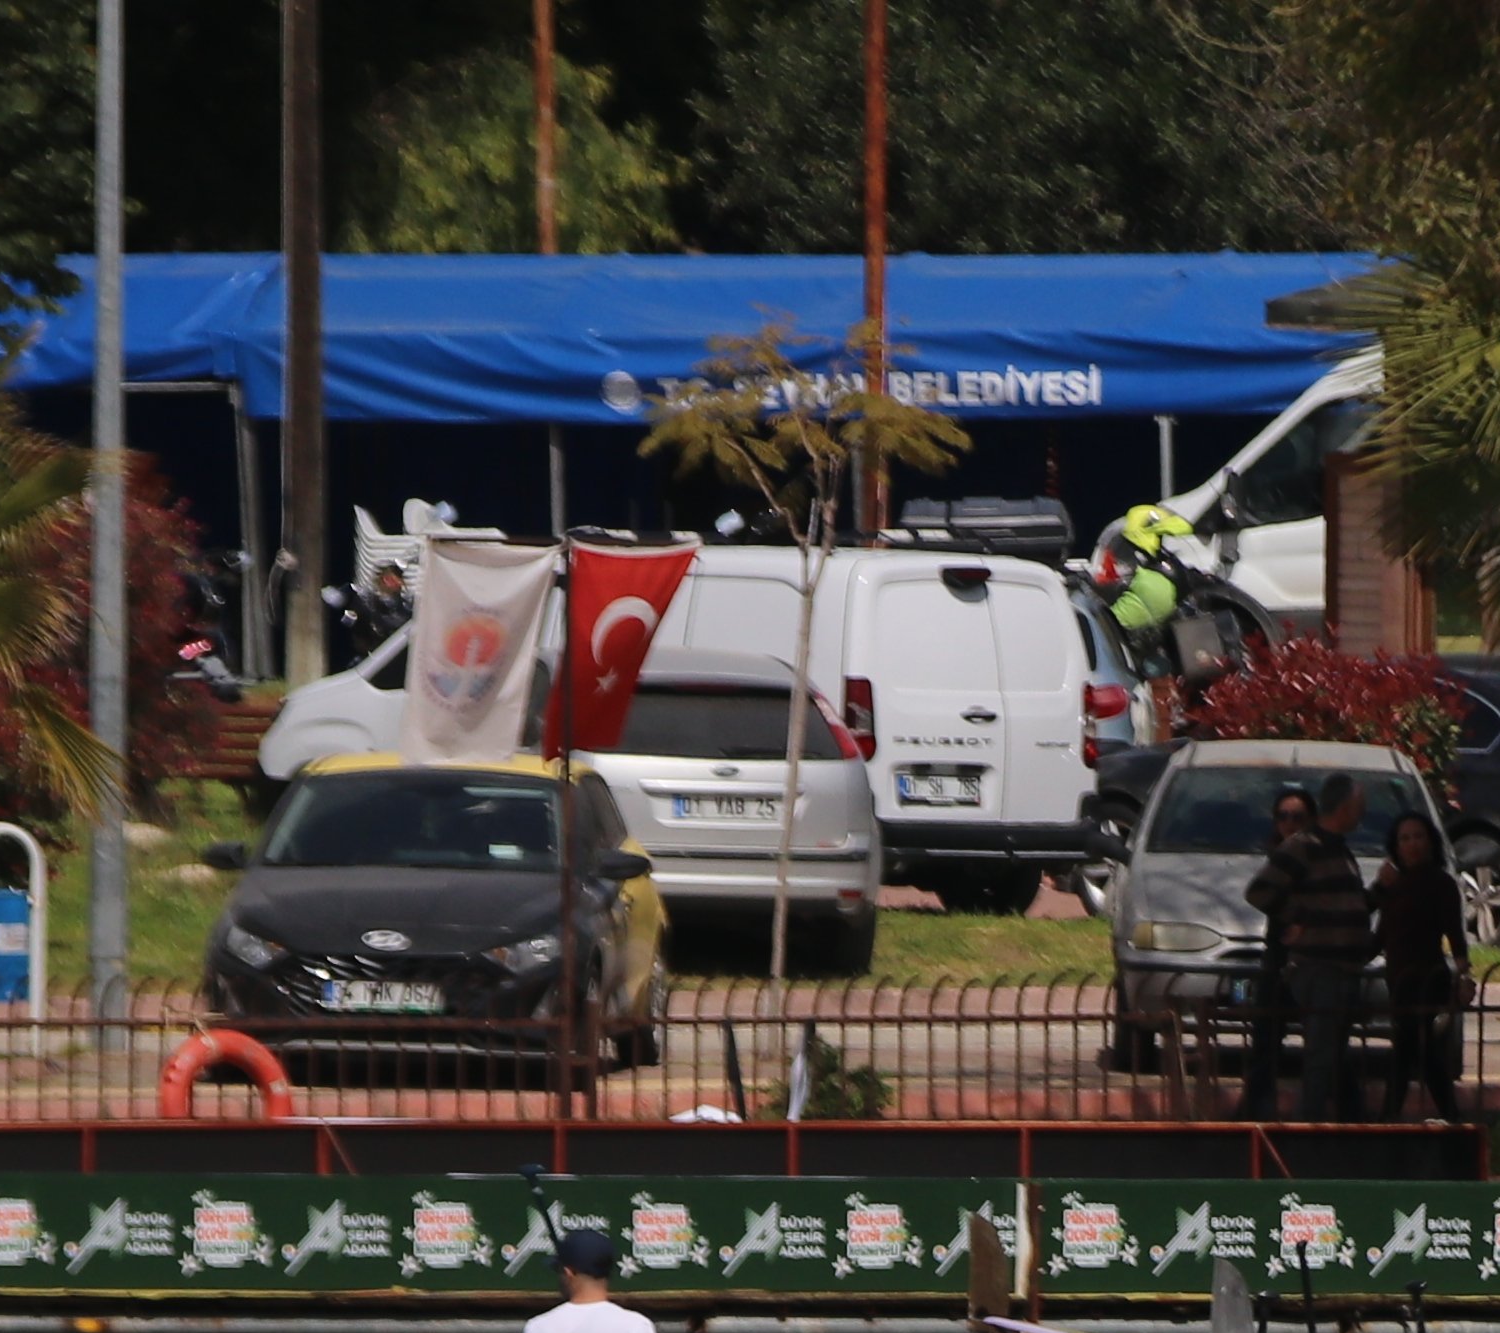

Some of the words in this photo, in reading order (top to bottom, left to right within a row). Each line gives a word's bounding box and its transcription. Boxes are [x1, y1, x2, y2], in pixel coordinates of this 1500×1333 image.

[887, 363, 1101, 407] BELEDİYESİ
[892, 735, 994, 747] PEUGEOT
[756, 797, 776, 816] 25
[125, 1211, 173, 1227] BÜYÜK
[342, 1213, 389, 1228] BÜYÜK
[563, 1214, 608, 1230] BÜYÜK
[780, 1215, 826, 1230] BÜYÜK
[1211, 1215, 1256, 1229] BÜYÜK
[1427, 1217, 1472, 1232] BÜYÜK
[348, 1228, 390, 1243] ŞEHİR
[785, 1230, 826, 1244] ŞEHİR
[1215, 1230, 1256, 1244] ŞEHİR
[1432, 1233, 1472, 1247] ŞEHİR
[124, 1242, 174, 1256] ADANA
[342, 1243, 391, 1257] ADANA
[778, 1245, 826, 1259] ADANA
[1210, 1244, 1256, 1258] ADANA
[1425, 1247, 1472, 1260] ADANA
